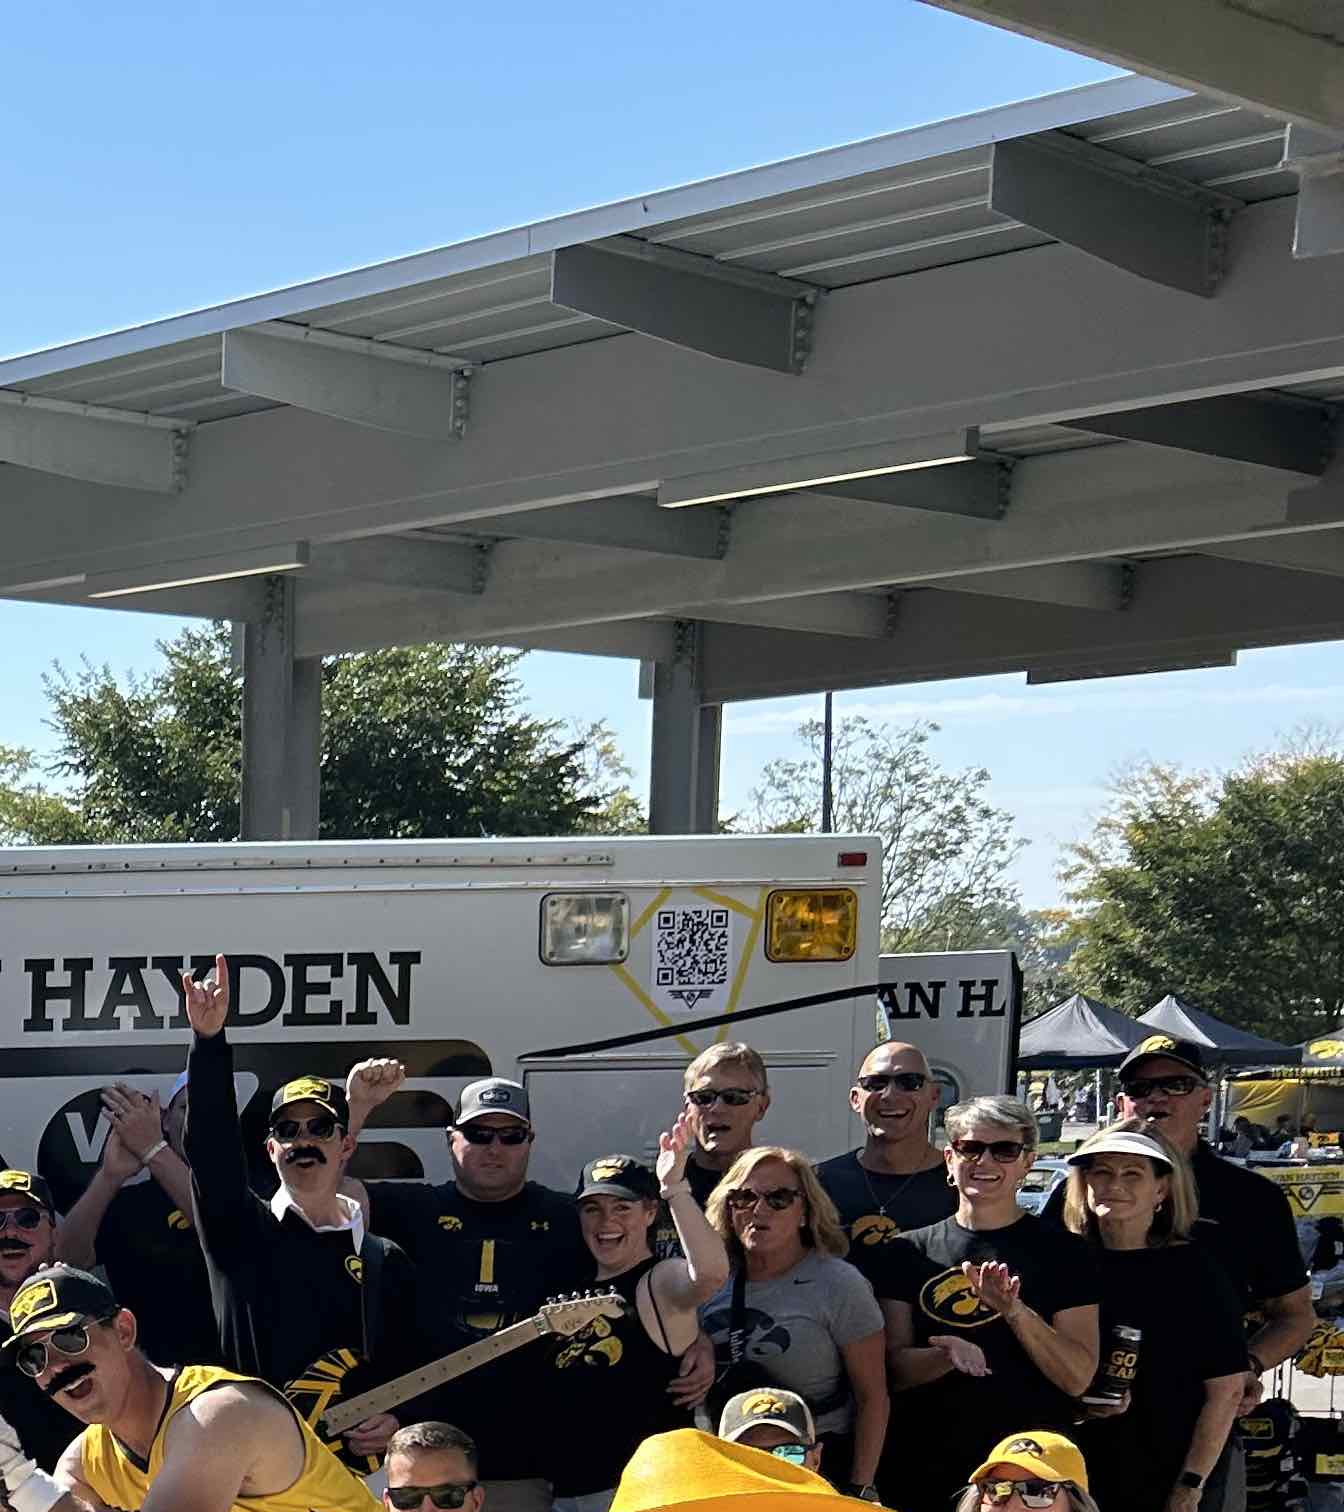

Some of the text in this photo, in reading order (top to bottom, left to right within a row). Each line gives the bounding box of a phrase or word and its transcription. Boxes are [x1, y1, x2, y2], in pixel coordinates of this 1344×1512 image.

[23, 951, 421, 1033] HAYDEN
[878, 979, 1006, 1019] AN H
[474, 1283, 499, 1293] IOWA
[1112, 1350, 1137, 1368] GO
